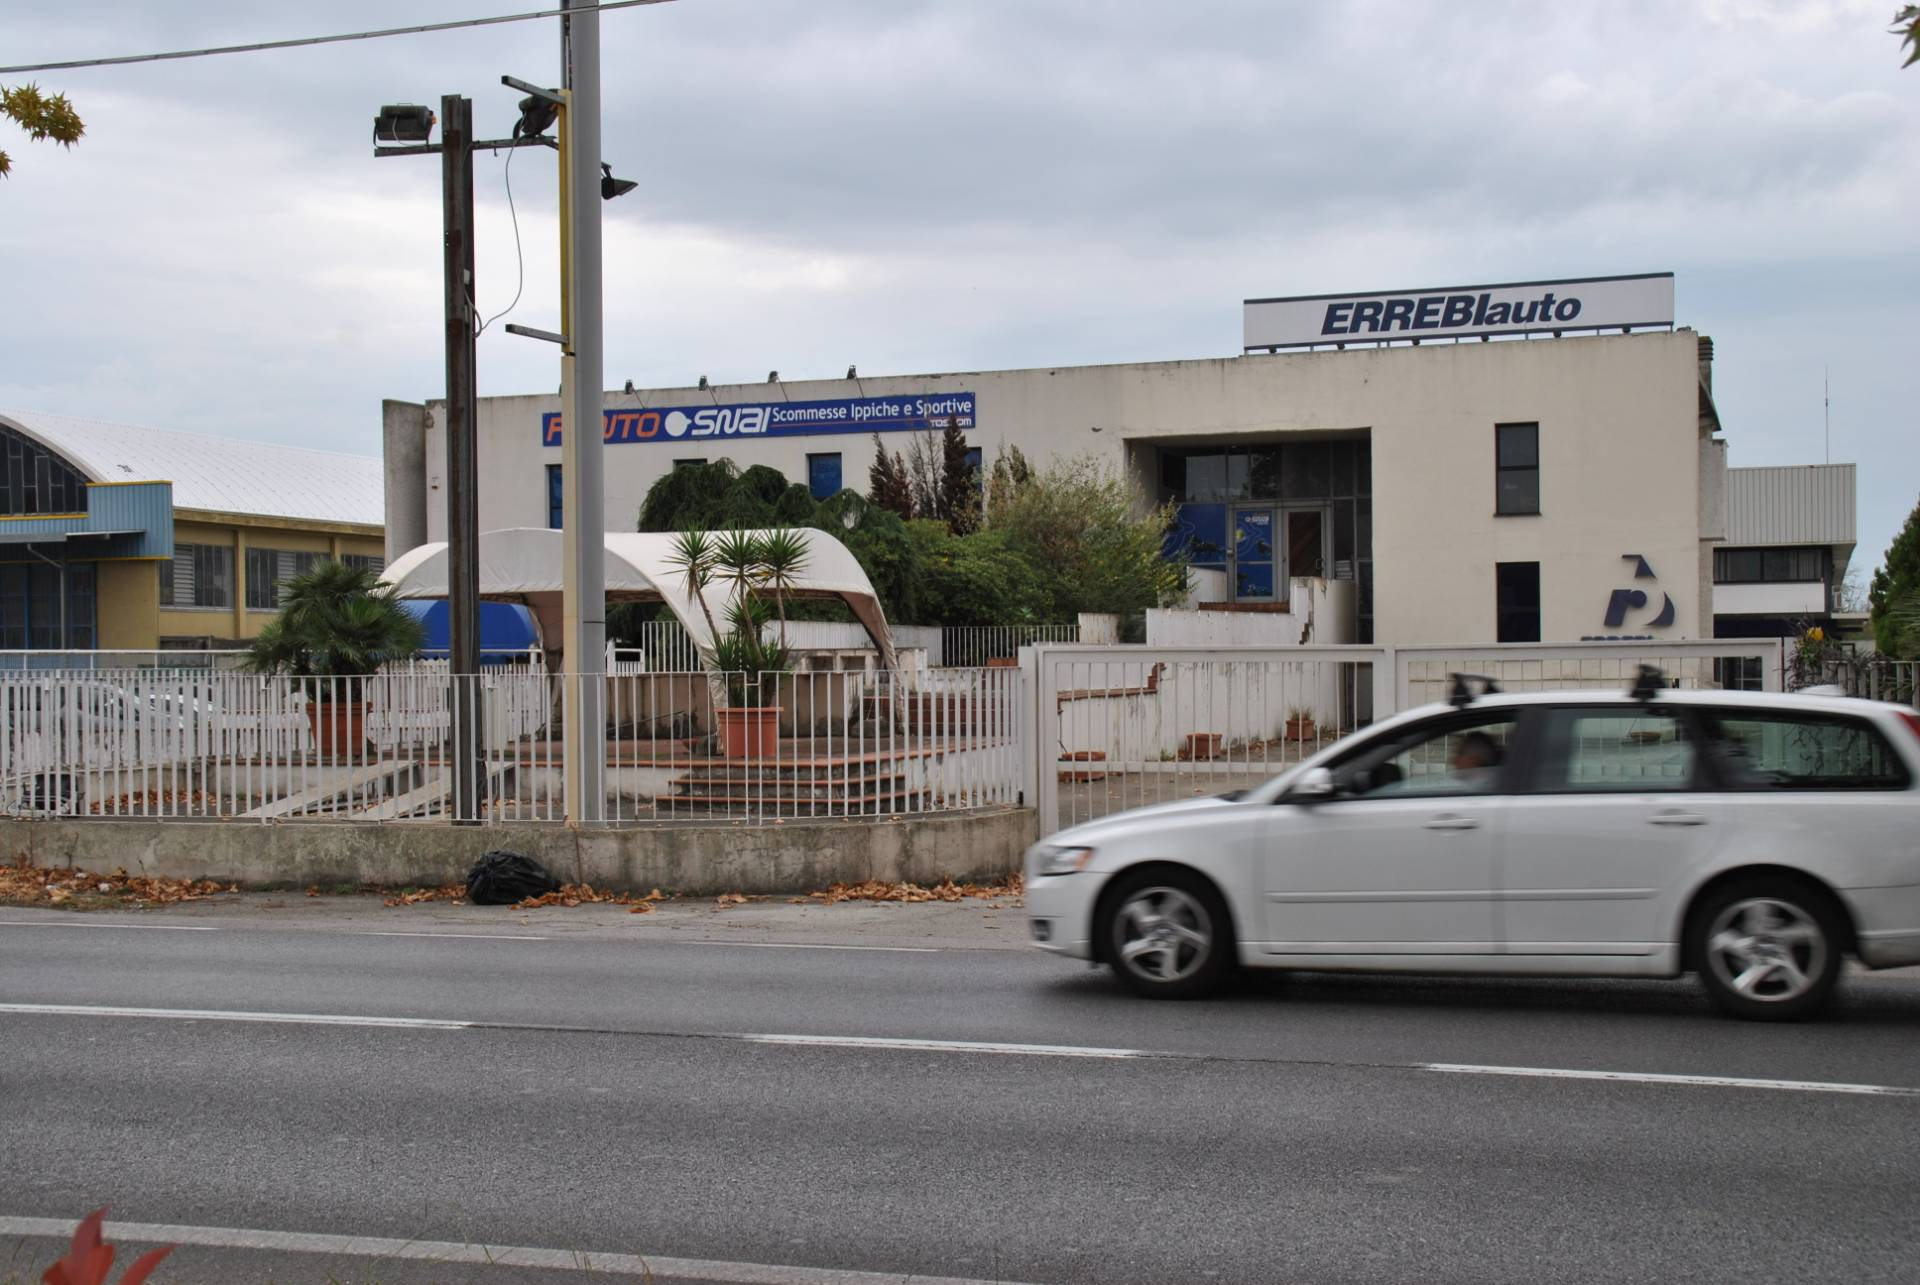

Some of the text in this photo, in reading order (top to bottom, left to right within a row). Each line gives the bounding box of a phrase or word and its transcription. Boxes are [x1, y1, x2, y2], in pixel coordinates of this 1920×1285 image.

[1321, 292, 1582, 336] ERREBIauto
[772, 398, 972, 422] Scommesse Ippiche e Sportive
